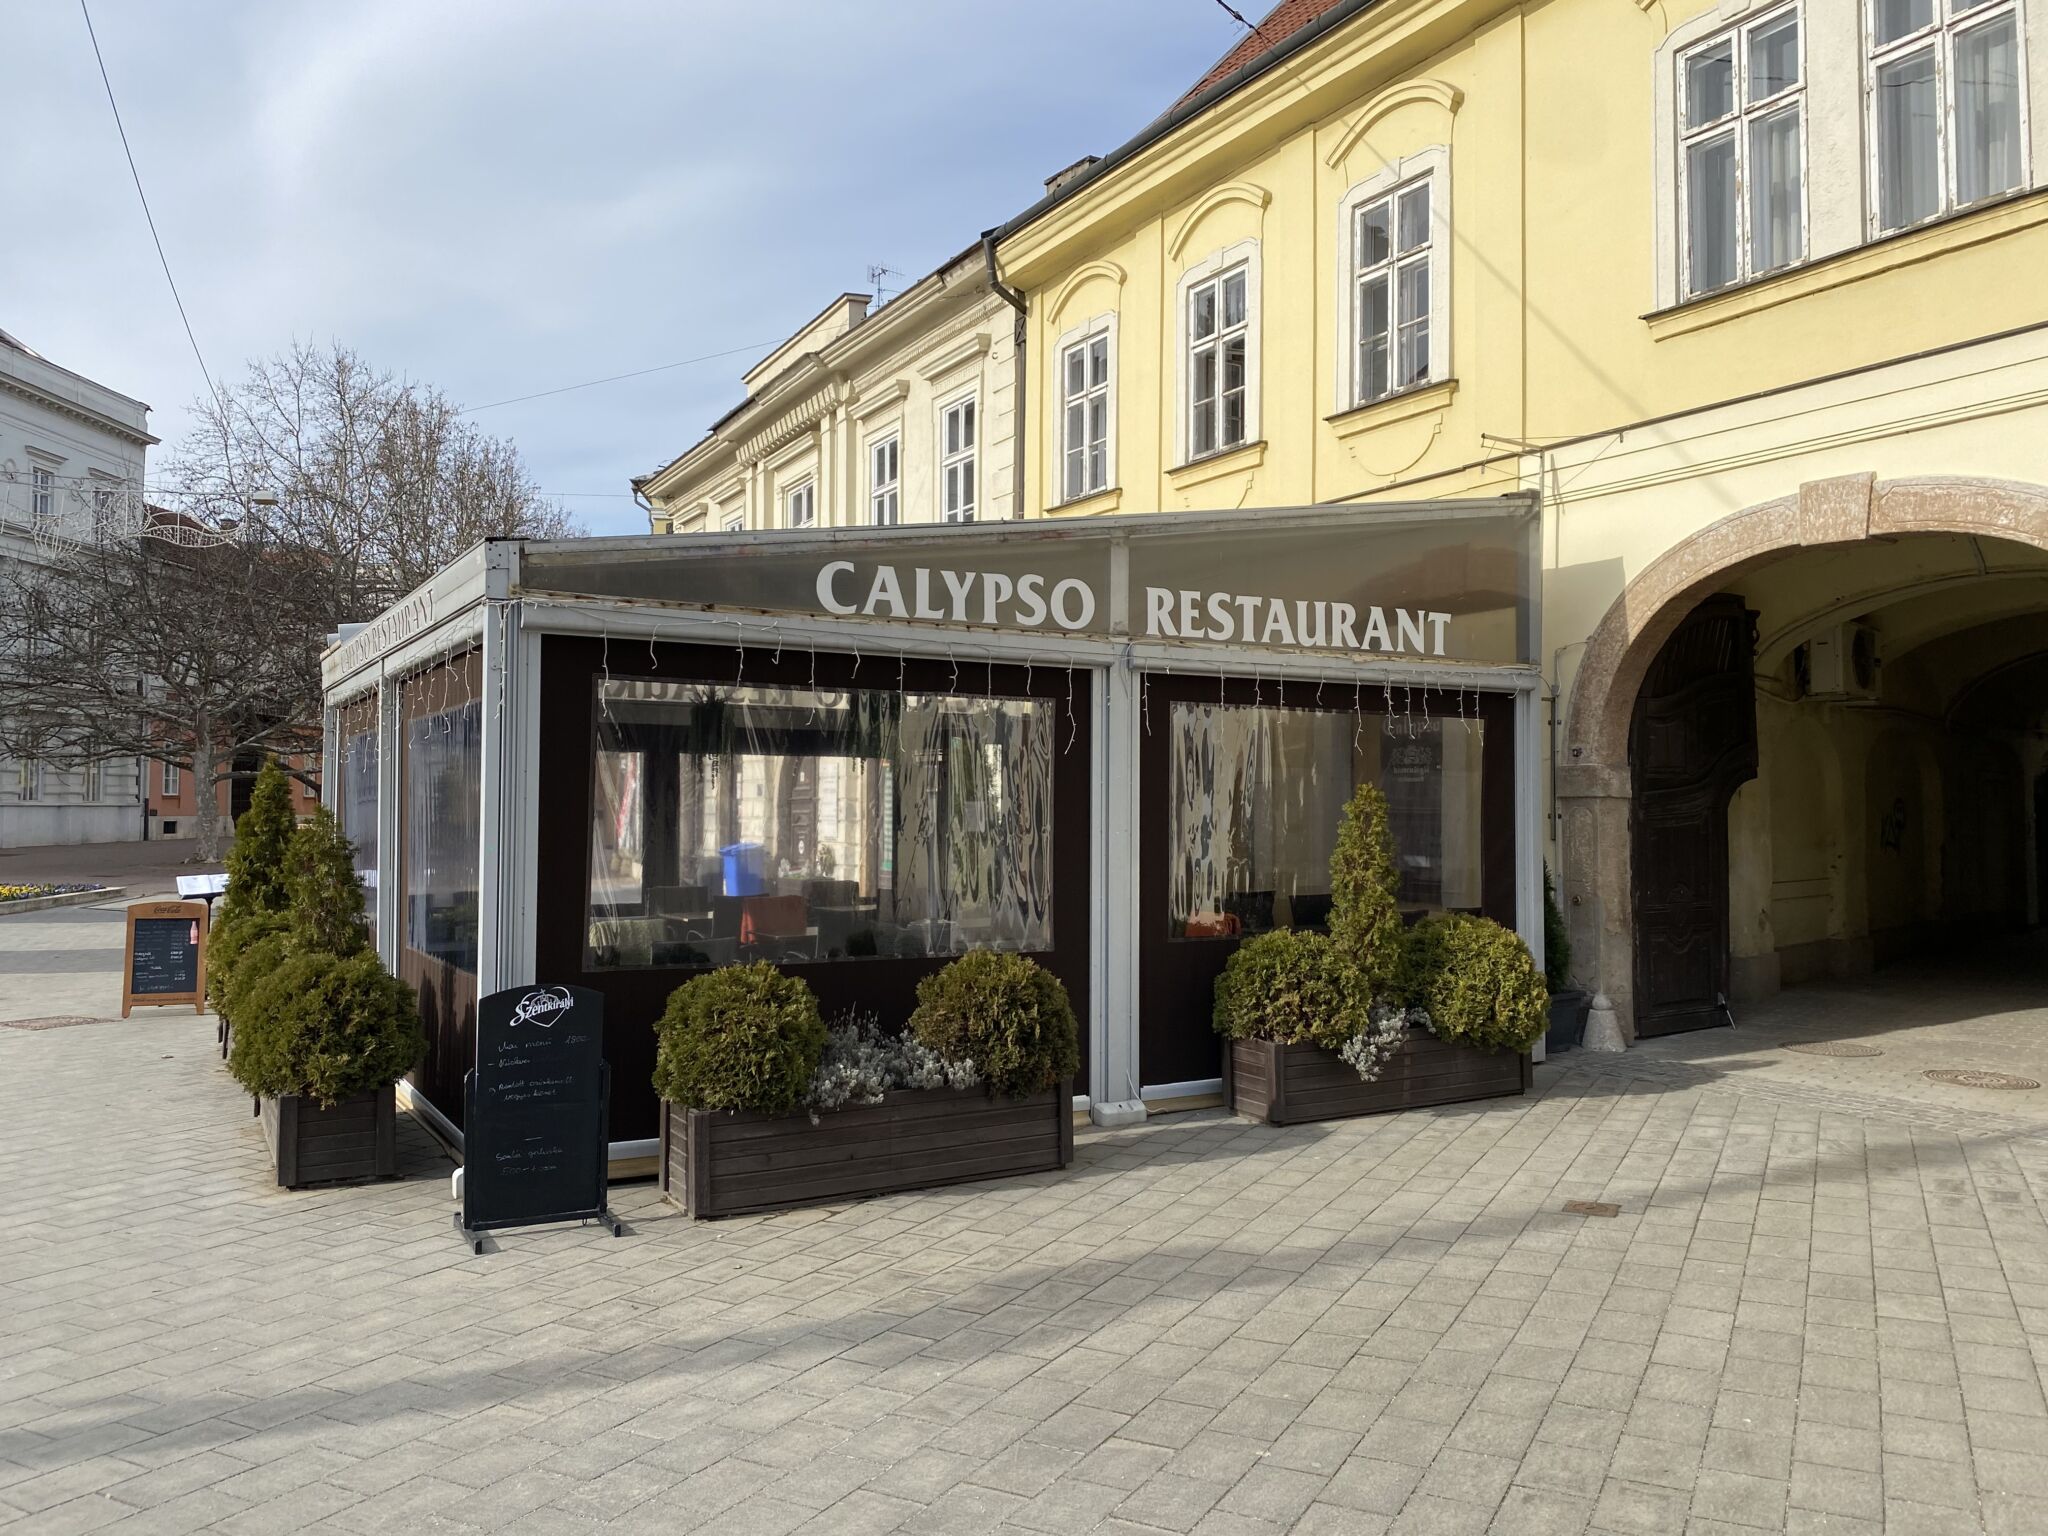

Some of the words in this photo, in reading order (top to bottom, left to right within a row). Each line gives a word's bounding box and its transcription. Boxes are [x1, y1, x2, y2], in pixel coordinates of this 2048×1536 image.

[340, 632, 371, 674] CALYPSO
[372, 588, 433, 655] RESTAURANT
[815, 559, 1096, 630] CALYPSO
[1145, 586, 1452, 656] RESTAURANT
[509, 996, 574, 1027] Szentkirályi
